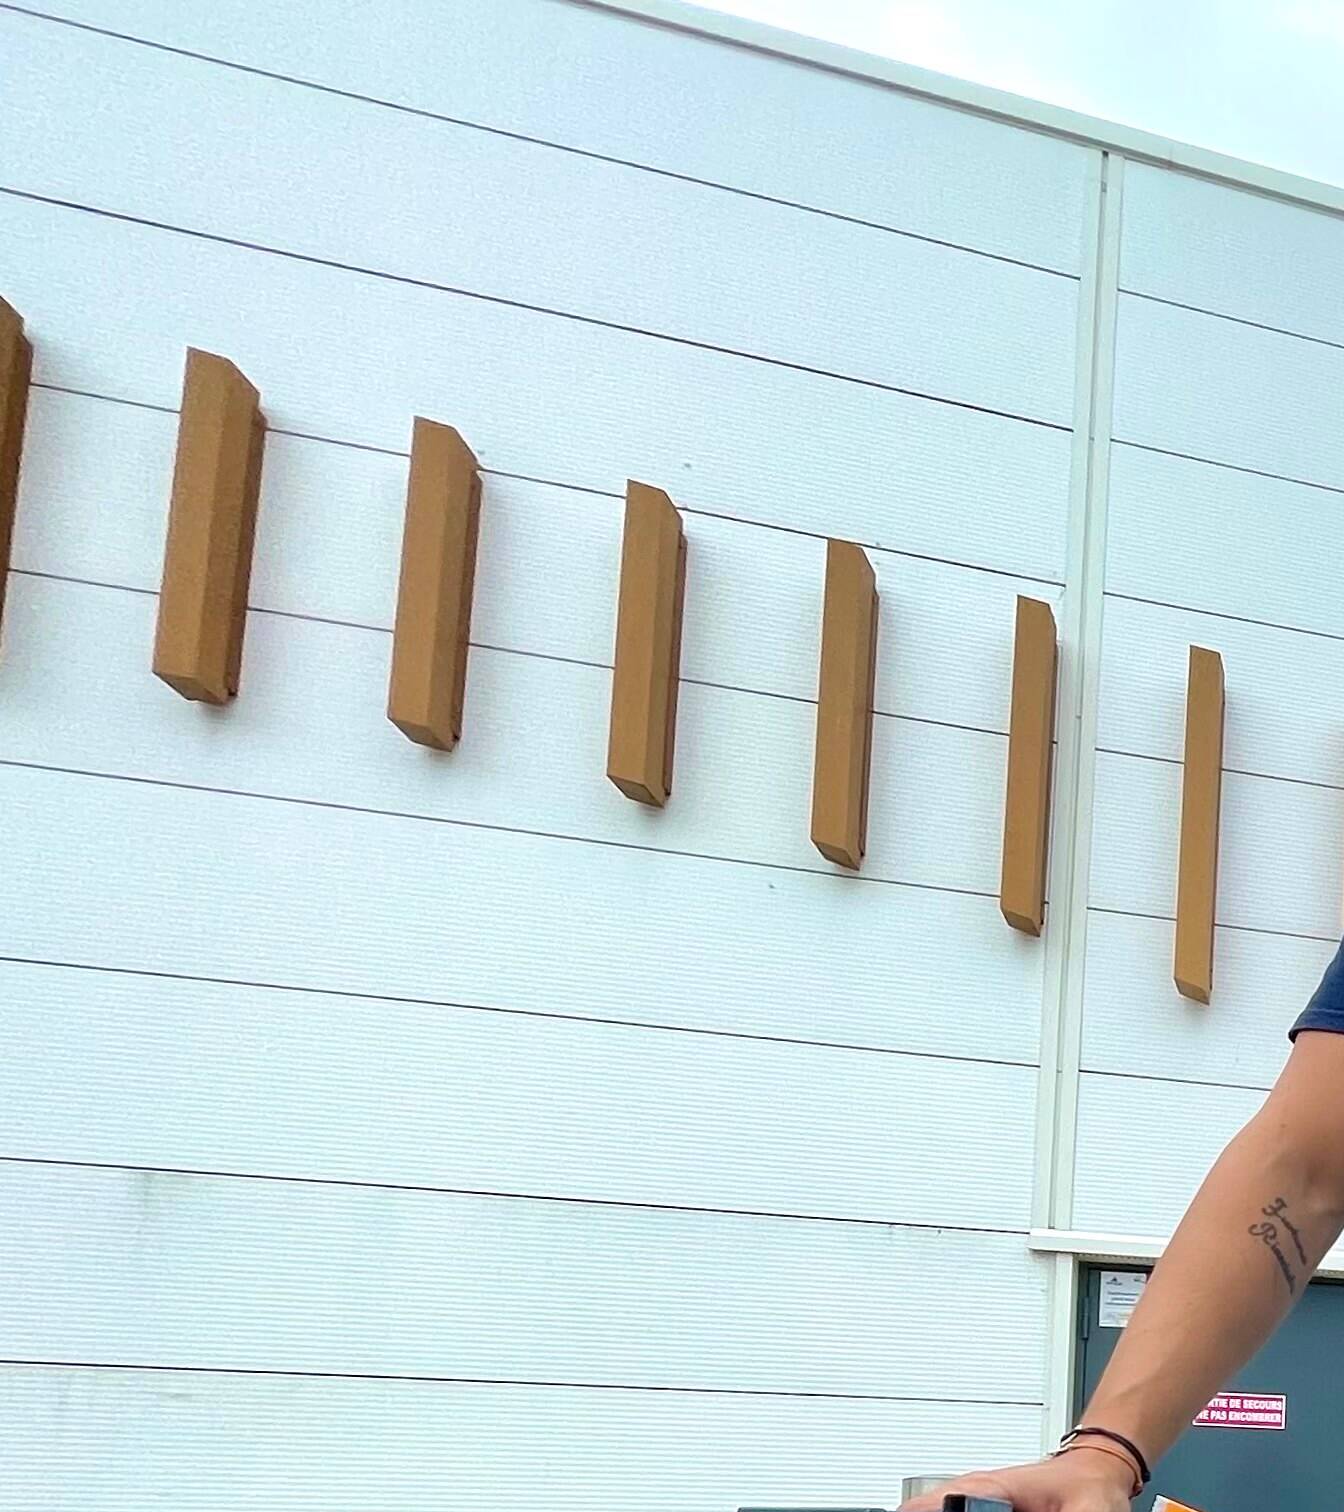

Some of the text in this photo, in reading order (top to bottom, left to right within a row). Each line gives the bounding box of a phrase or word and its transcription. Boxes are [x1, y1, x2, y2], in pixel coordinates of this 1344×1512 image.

[1228, 1398, 1241, 1409] DE
[1242, 1400, 1283, 1411] SECOURS
[1210, 1410, 1227, 1422] PAS
[1228, 1411, 1283, 1424] ENCOMBRER
